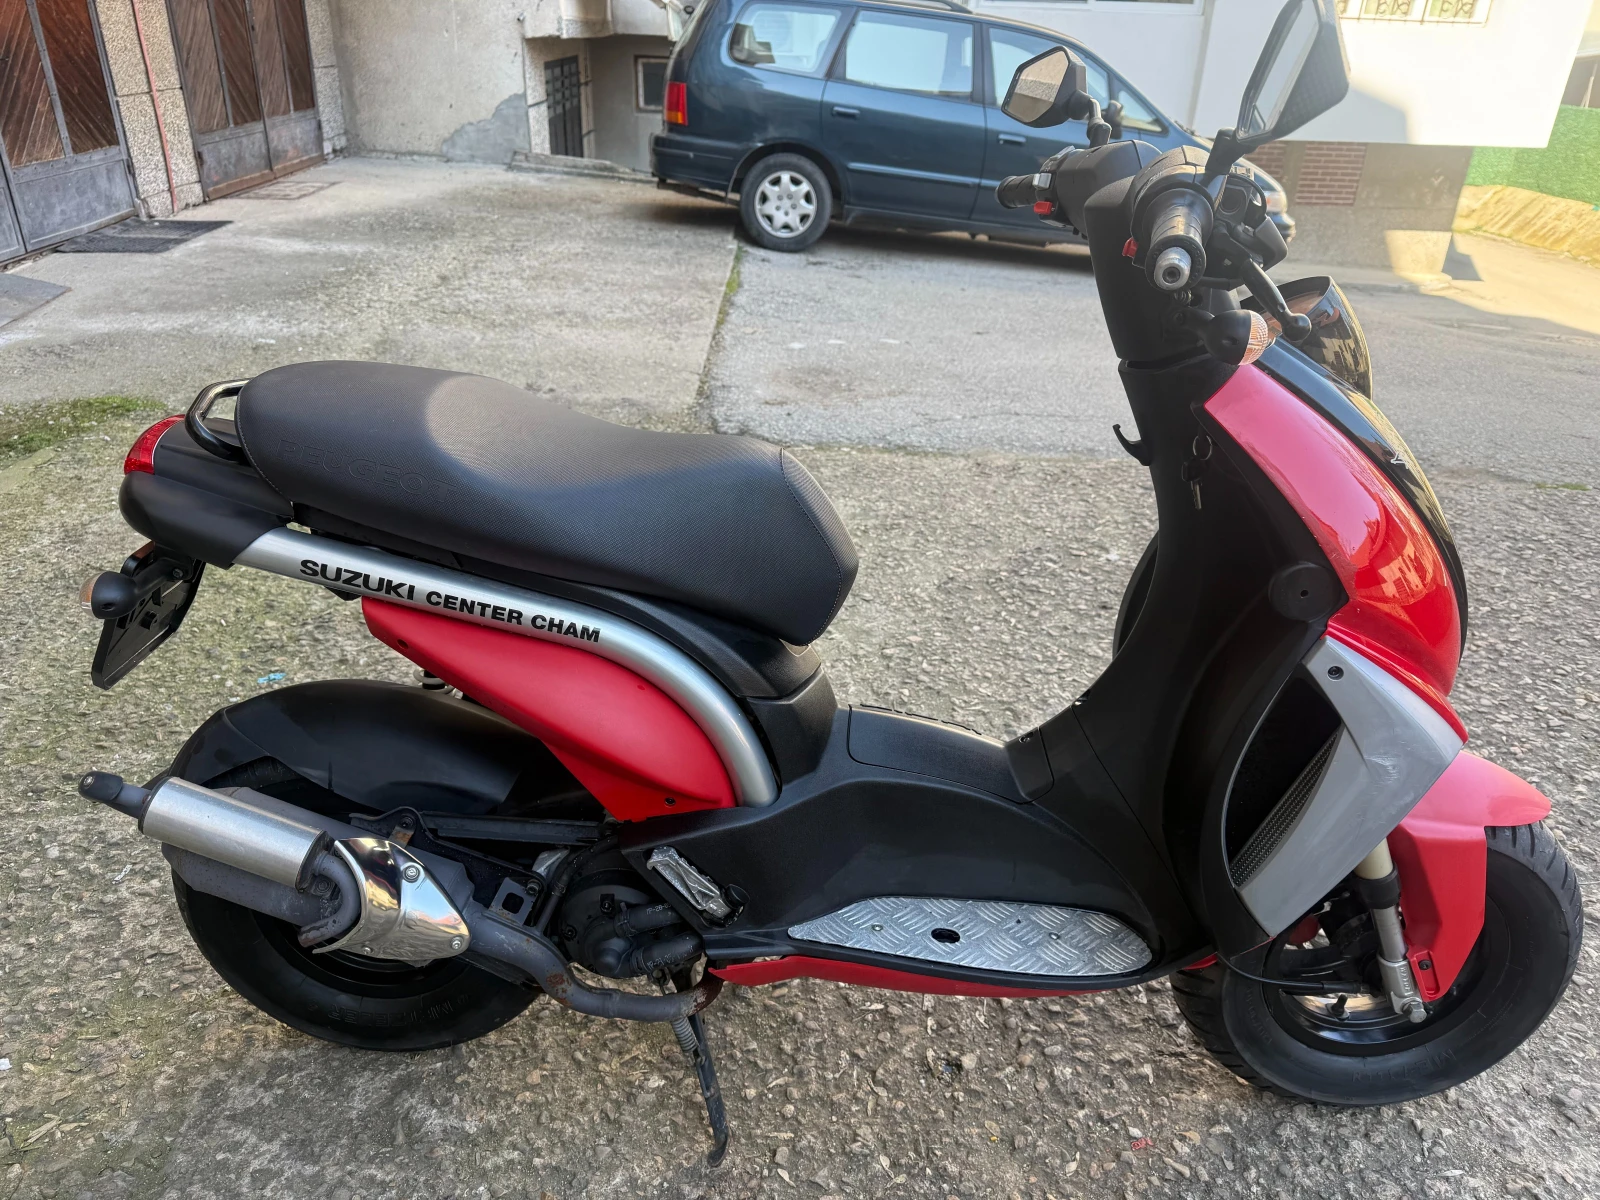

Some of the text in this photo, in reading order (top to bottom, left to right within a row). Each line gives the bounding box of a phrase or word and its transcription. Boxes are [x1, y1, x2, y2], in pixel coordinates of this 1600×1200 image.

[276, 439, 457, 502] PEUGEOT
[300, 559, 602, 643] SUZUKI CENTER CHAM
